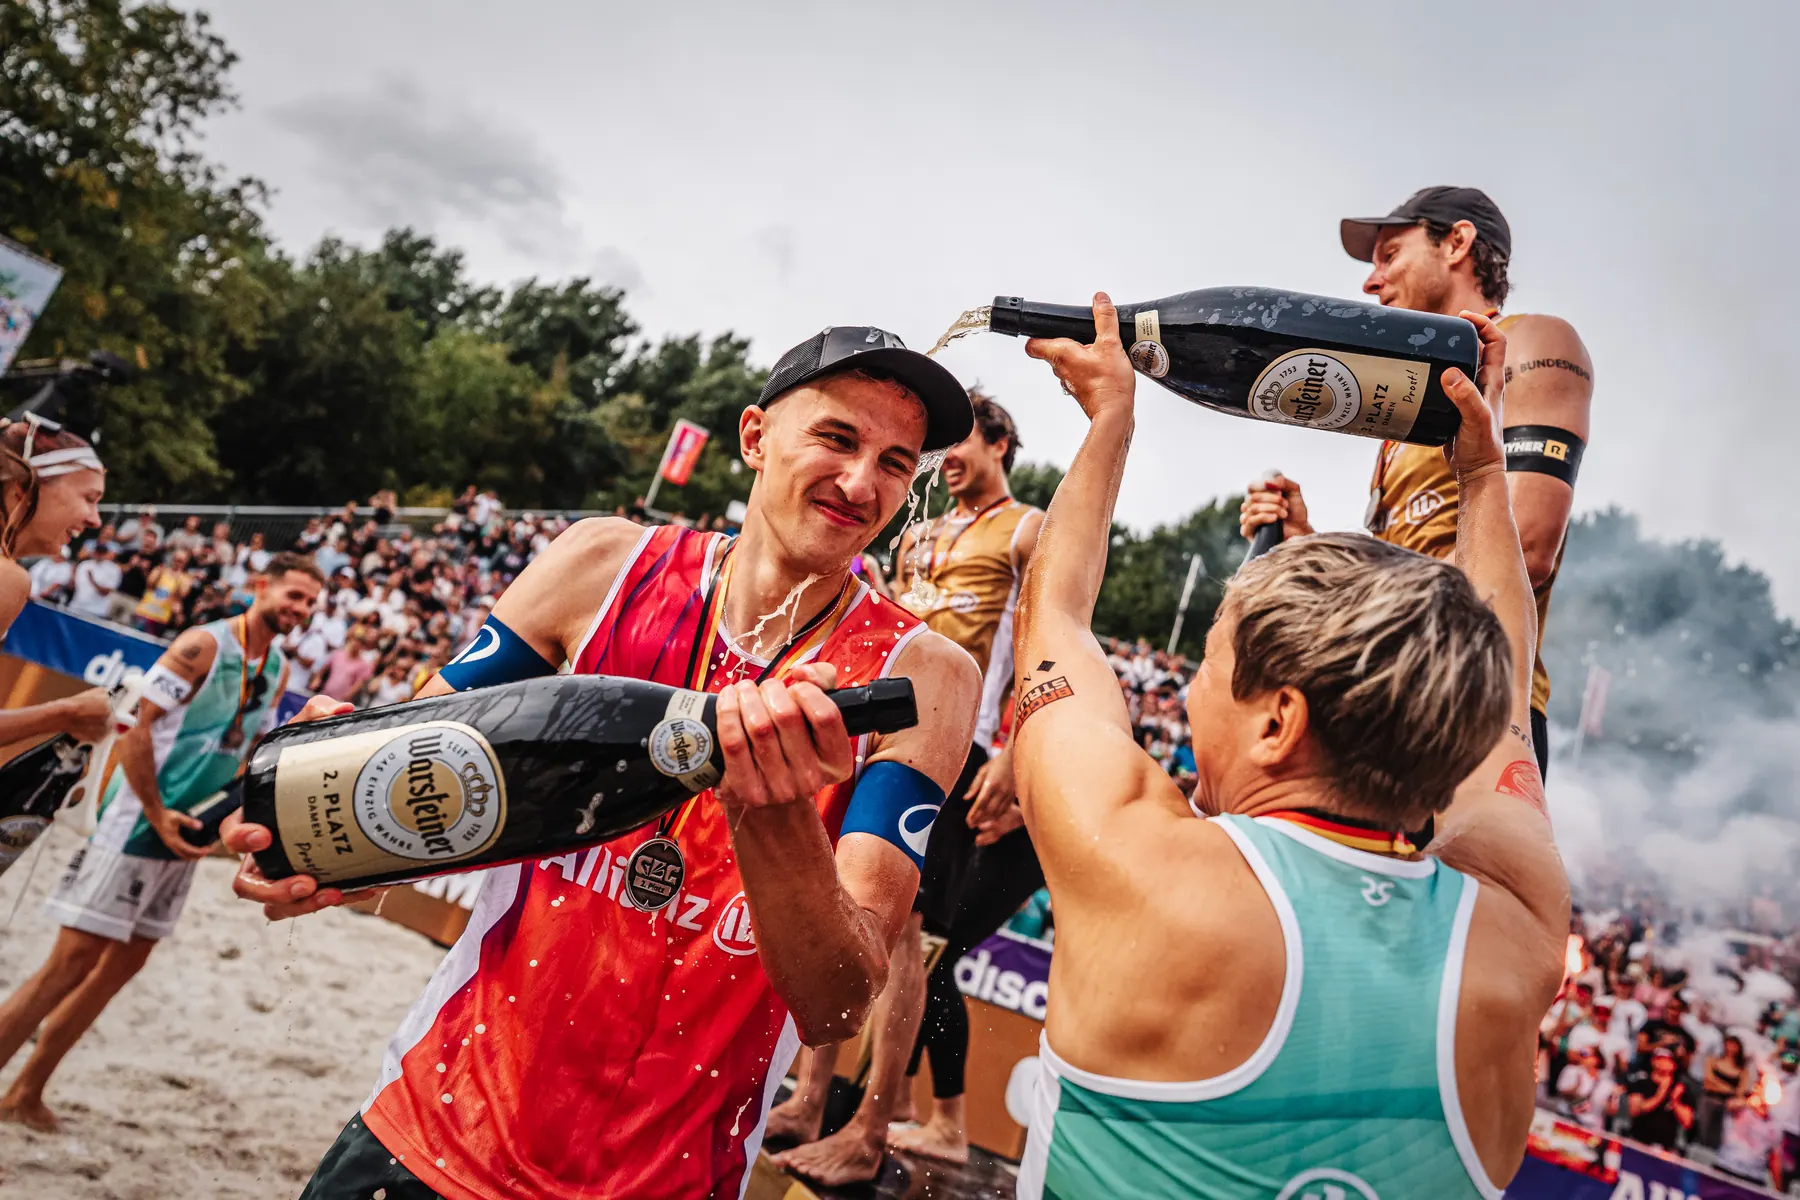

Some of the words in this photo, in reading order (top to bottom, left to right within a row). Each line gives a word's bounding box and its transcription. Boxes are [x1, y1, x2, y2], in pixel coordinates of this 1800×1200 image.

[1279, 365, 1297, 379] 1753
[1333, 372, 1352, 400] WAHRE
[1402, 368, 1419, 404] Prost!
[1292, 358, 1328, 424] arsteiner
[1367, 383, 1389, 425] PLATZ
[1335, 401, 1353, 424] EINZIG
[1382, 401, 1397, 427] DAMEN
[375, 752, 397, 773] DAS
[447, 740, 470, 758] SEIT
[322, 769, 339, 789] 2.
[364, 776, 379, 821] EINZIG
[406, 732, 456, 856] Warsteiner
[306, 795, 323, 839] DAMEN
[323, 792, 354, 856] PLATZ
[374, 823, 413, 851] WAHRE
[648, 882, 666, 894] Platz
